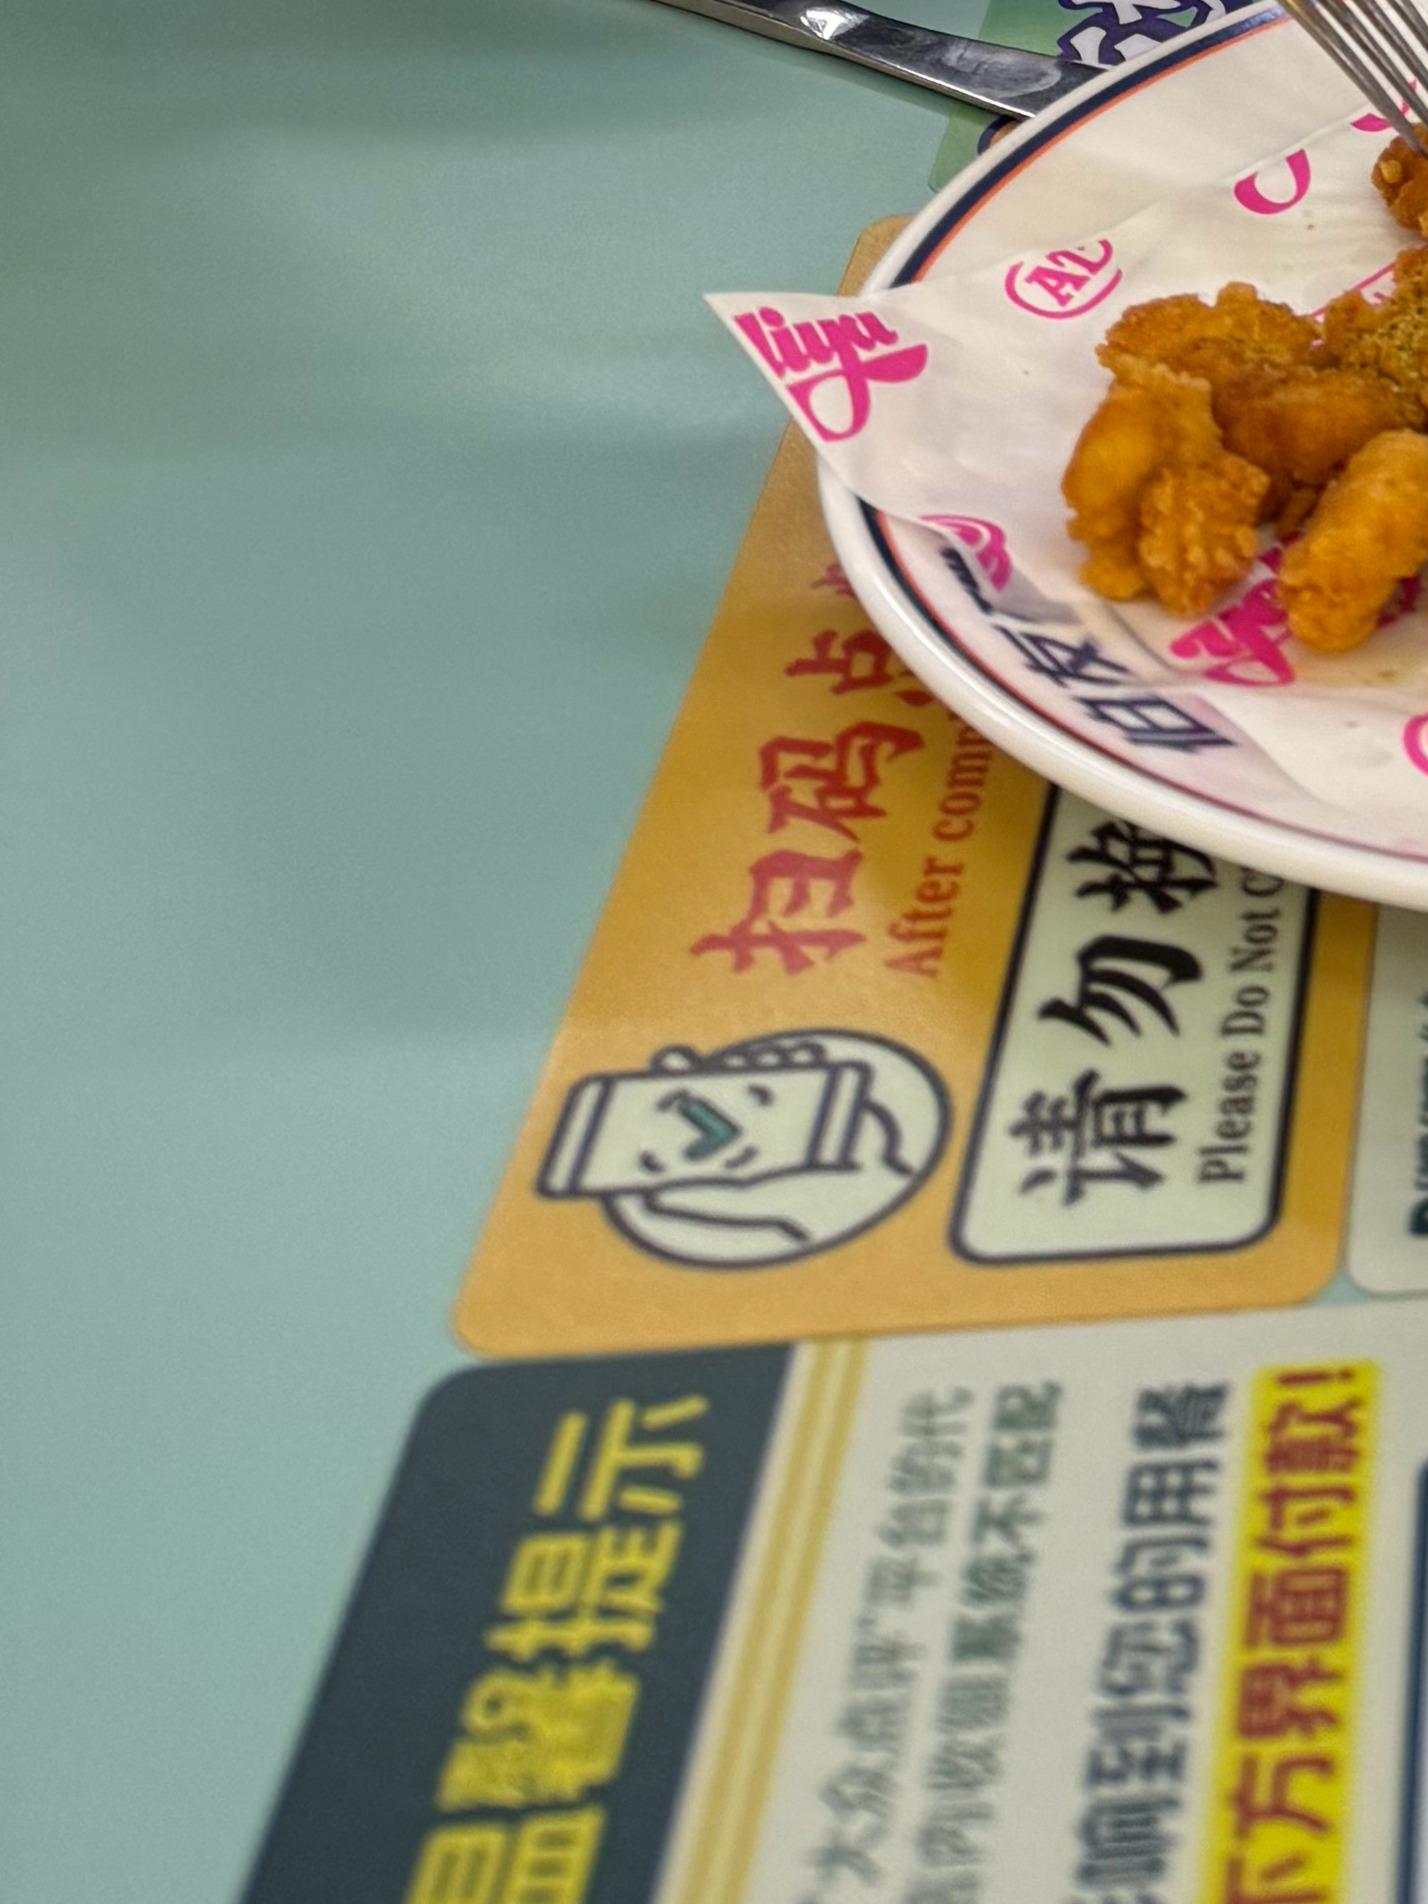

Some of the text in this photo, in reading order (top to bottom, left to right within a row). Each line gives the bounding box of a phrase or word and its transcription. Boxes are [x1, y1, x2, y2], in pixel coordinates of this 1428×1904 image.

[885, 856, 971, 981] After
[1229, 898, 1284, 976] Not
[1222, 979, 1271, 1035] Do
[1197, 1039, 1263, 1184] Please
[1070, 1380, 1232, 1904] 响到您的用餐
